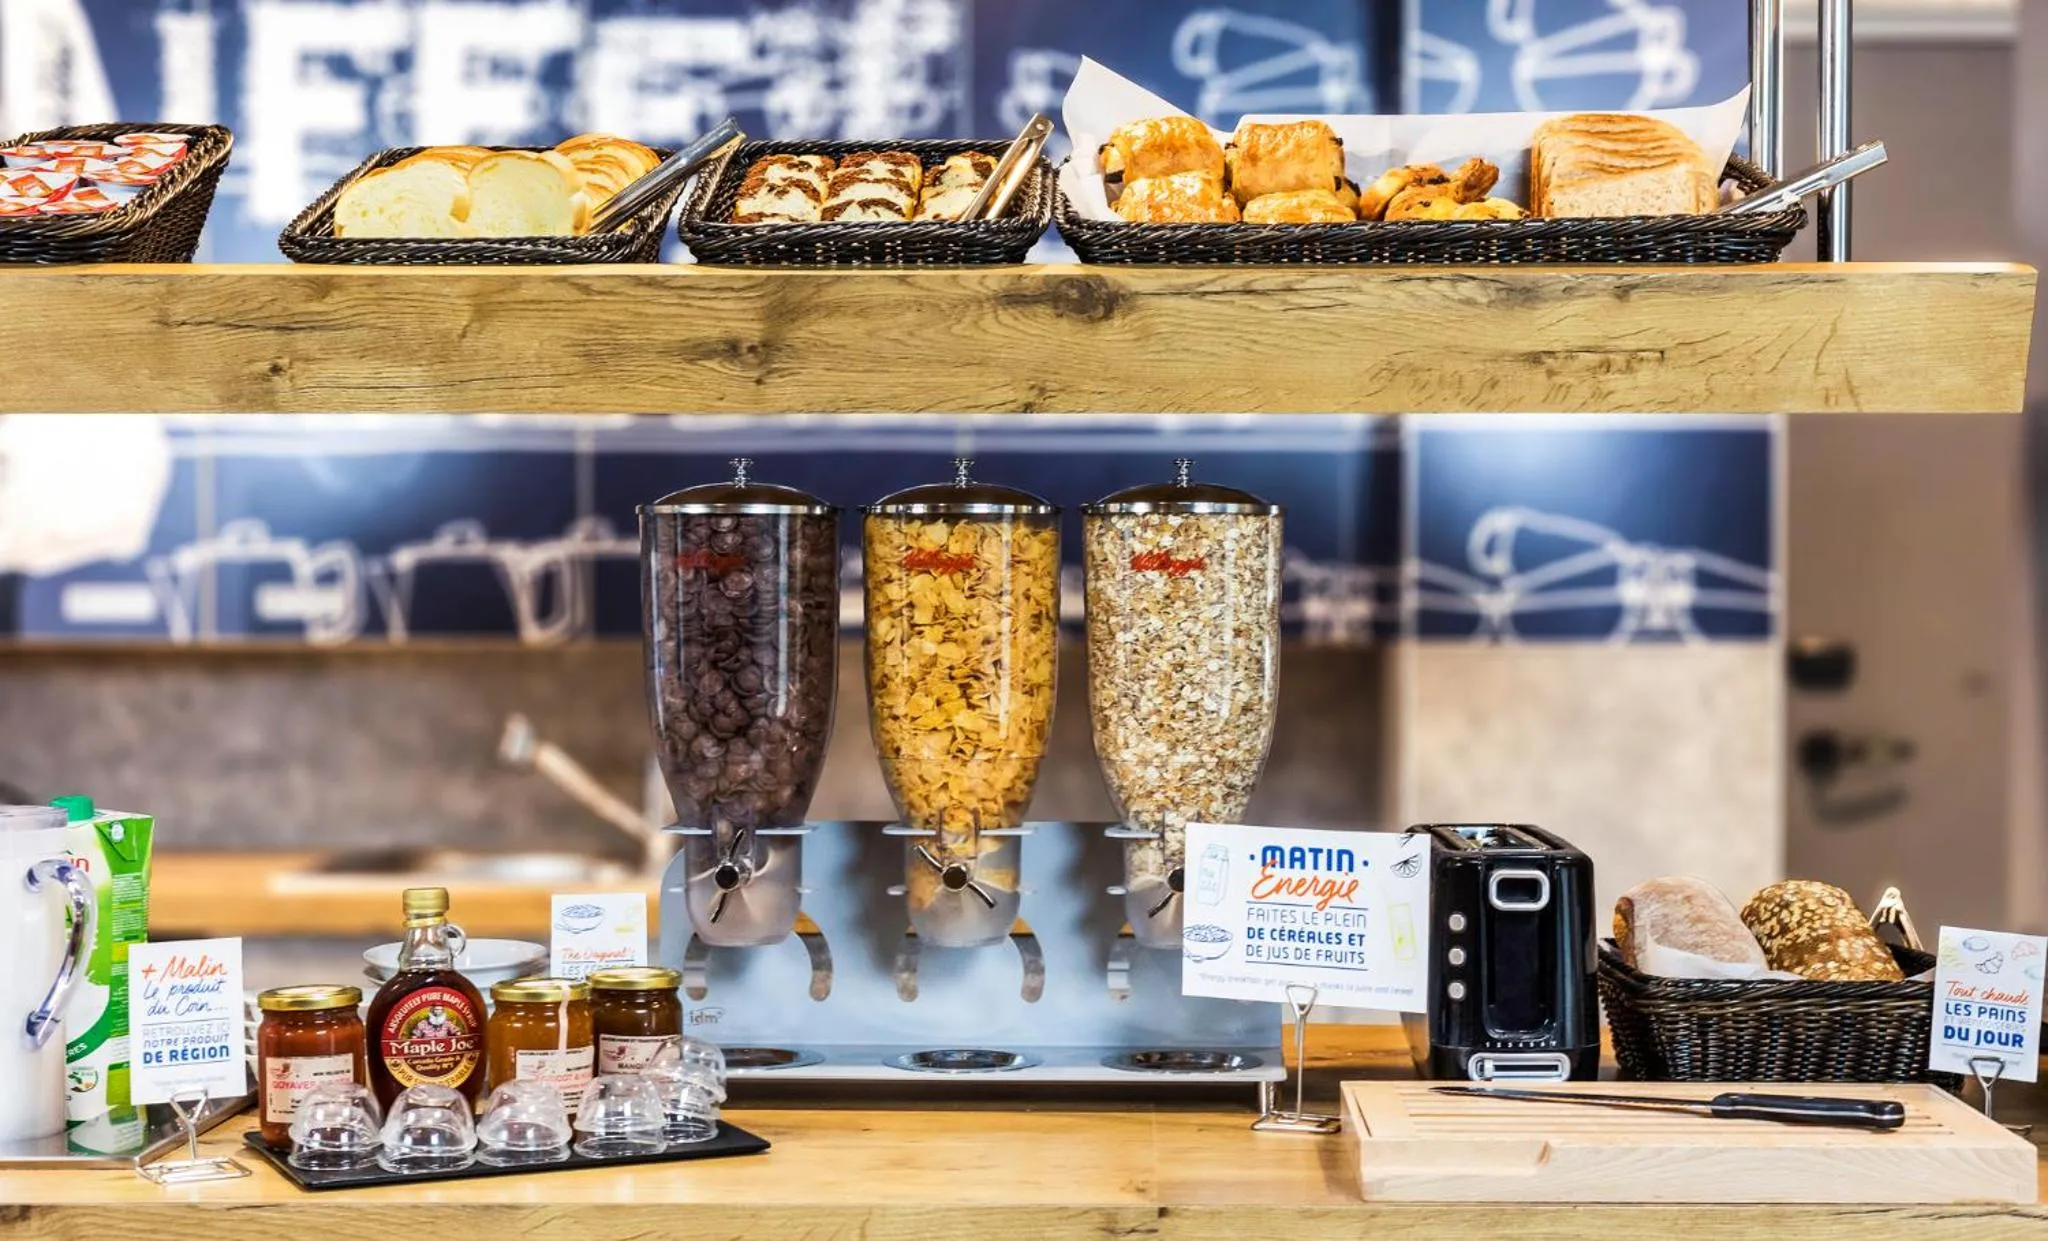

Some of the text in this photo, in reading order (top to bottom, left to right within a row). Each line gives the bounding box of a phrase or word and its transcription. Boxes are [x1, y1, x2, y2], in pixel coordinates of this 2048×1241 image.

[1261, 845, 1354, 873] MATIN
[1251, 858, 1360, 911] Energie
[1247, 907, 1367, 928] FAITES LE PLEIN
[1247, 926, 1366, 947] DE CÉRÉALES ET
[1246, 944, 1365, 965] DE JUS DE FRUITS
[160, 954, 228, 982] Malin
[166, 979, 227, 1001] produit
[1946, 980, 1978, 998] Tout
[147, 1000, 170, 1017] du
[1945, 1001, 2027, 1024] LES PAINS
[142, 1022, 213, 1037] RETROUVEZ
[1944, 1025, 2024, 1049] DU JOUR
[144, 1037, 179, 1049] NOTRE
[182, 1033, 230, 1046] PRODUIT
[389, 1039, 475, 1056] Maple Joe
[143, 1045, 230, 1065] DE RÉGION
